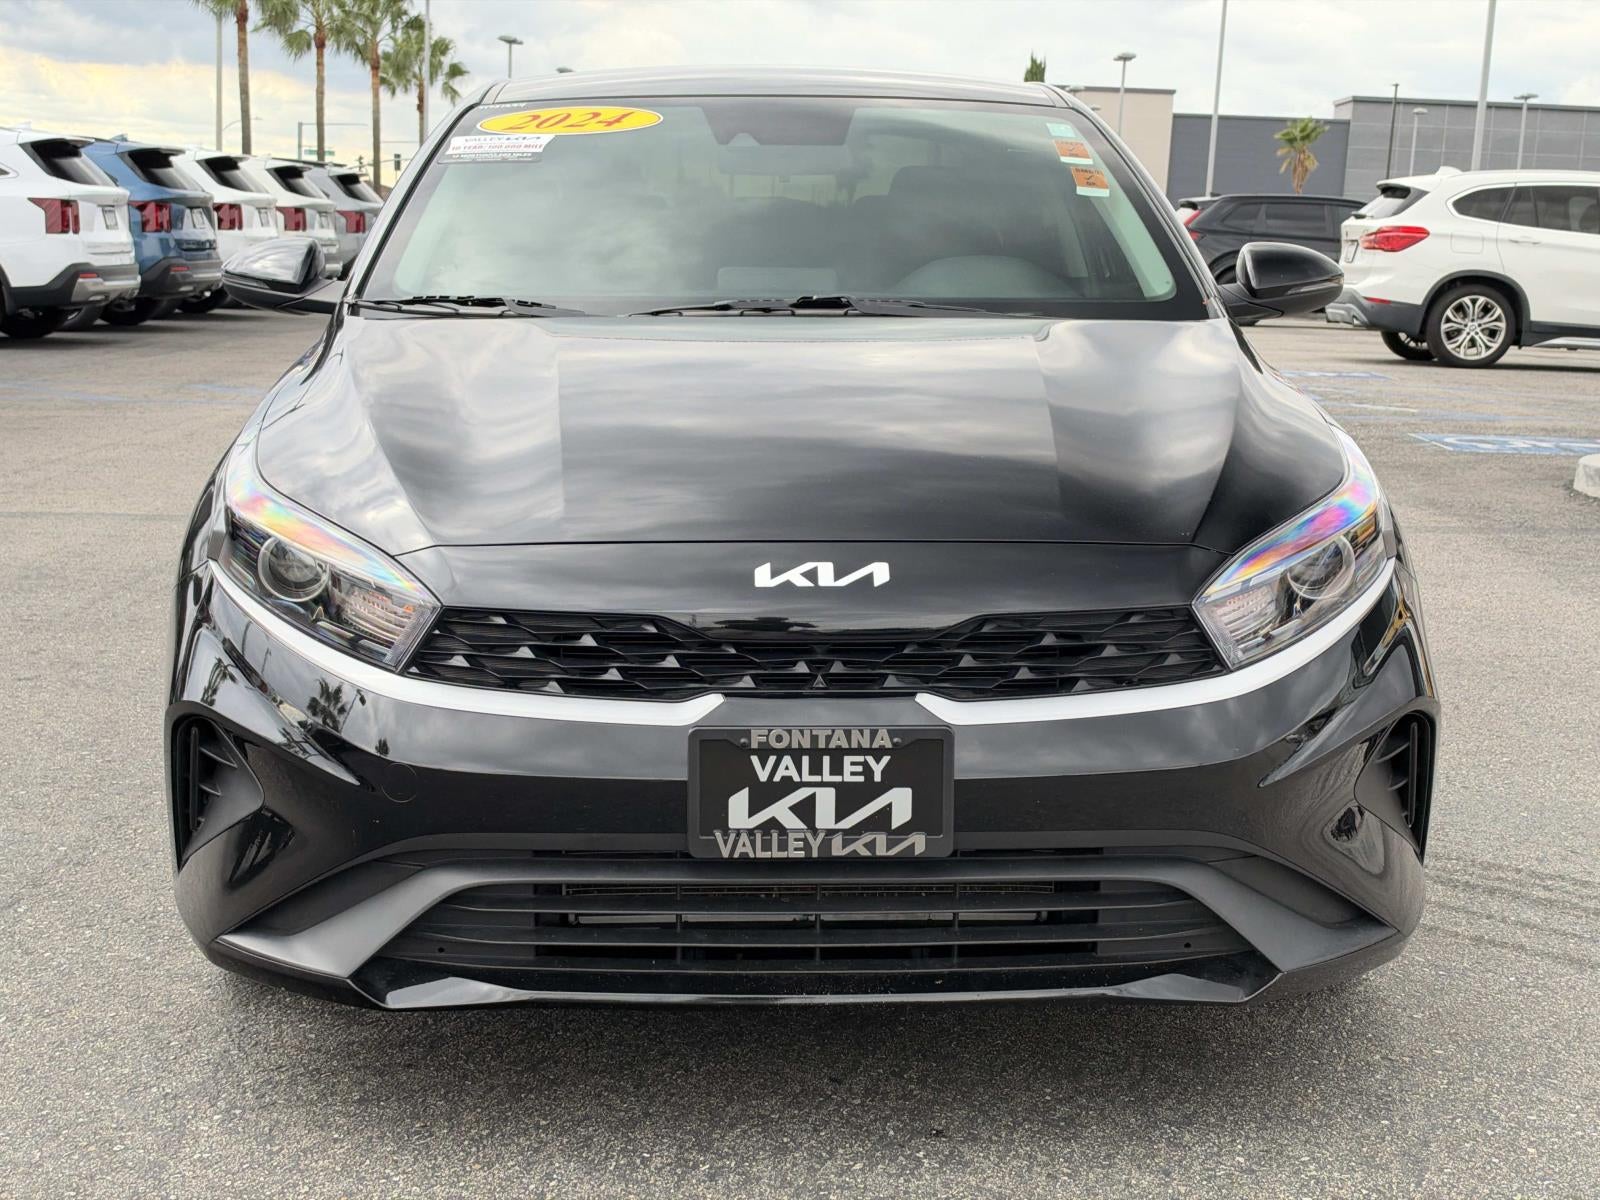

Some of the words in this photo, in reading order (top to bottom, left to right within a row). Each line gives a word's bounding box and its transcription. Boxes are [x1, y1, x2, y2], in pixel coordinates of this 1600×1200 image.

[503, 111, 636, 131] 2024
[754, 562, 890, 587] KIA
[750, 728, 893, 749] FONTANA
[750, 755, 891, 782] VALLEY
[728, 787, 913, 830] KIA
[713, 830, 826, 858] VALLEY
[831, 832, 926, 856] KIA
